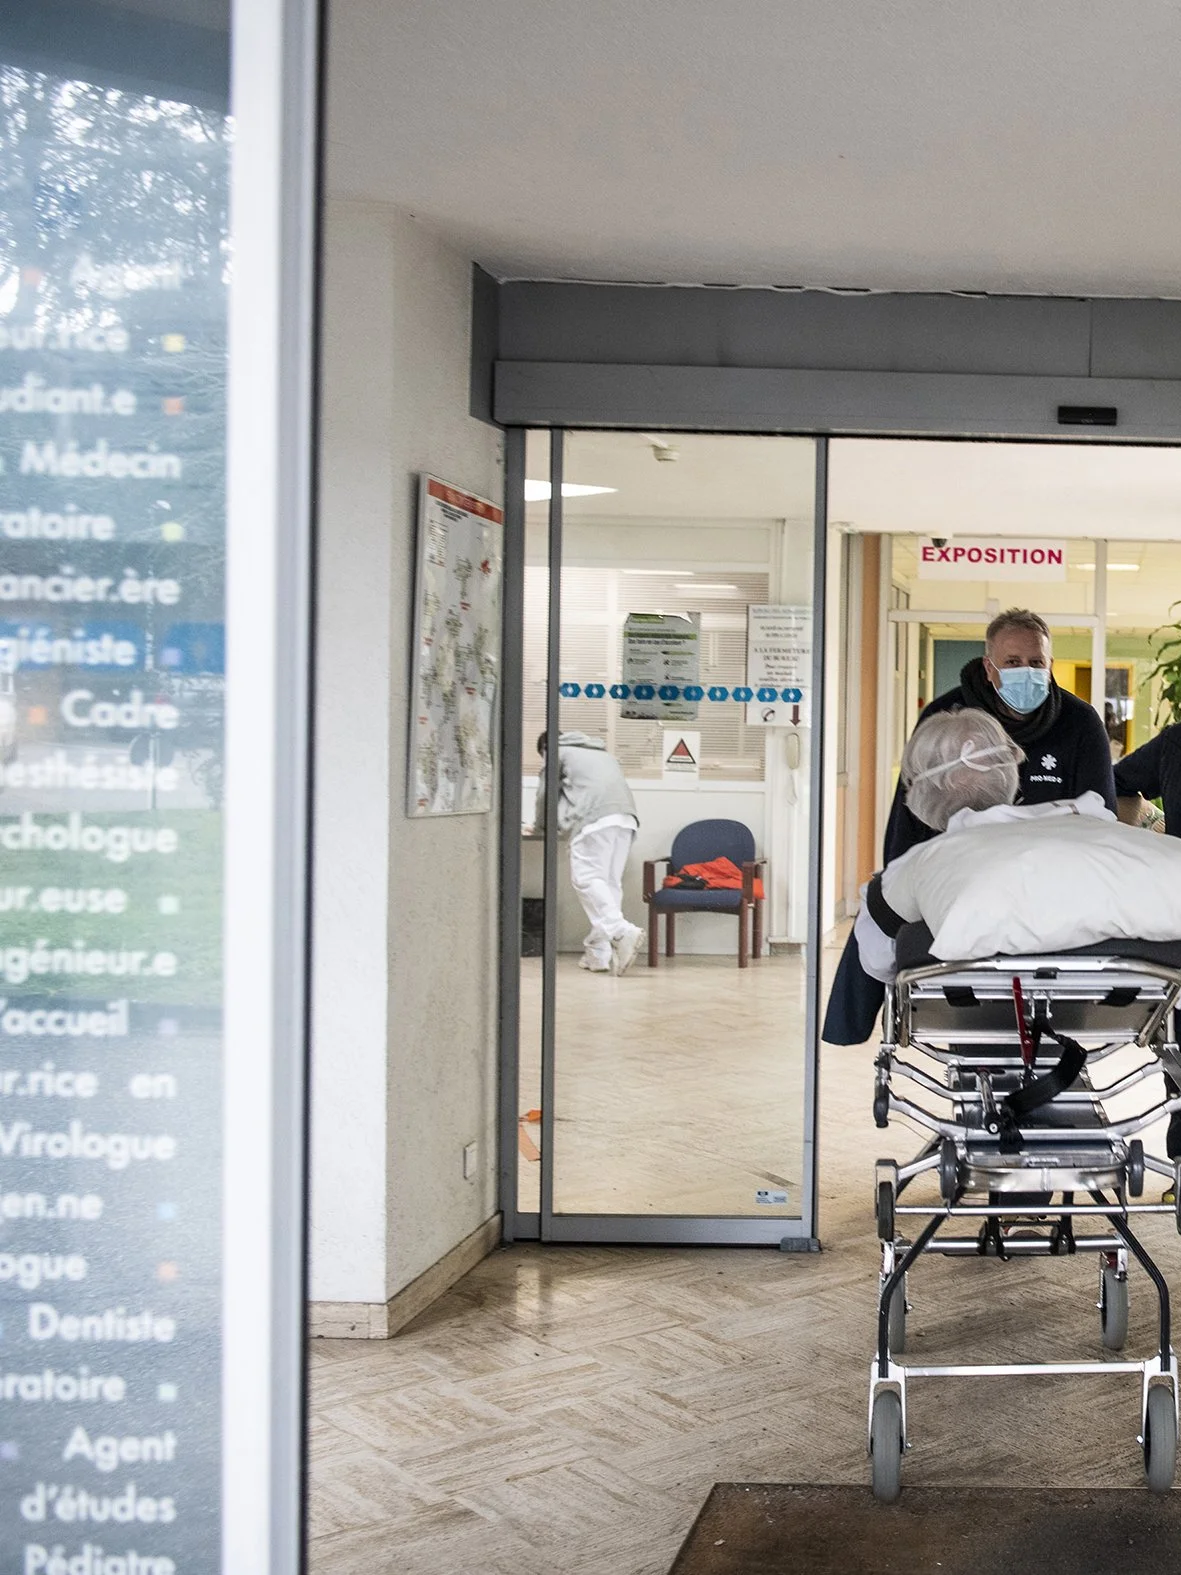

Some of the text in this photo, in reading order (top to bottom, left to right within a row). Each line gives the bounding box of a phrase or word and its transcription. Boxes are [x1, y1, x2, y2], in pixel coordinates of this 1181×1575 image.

[20, 438, 182, 479] Médecin
[0, 502, 115, 541] atoire
[922, 546, 1063, 565] EXPOSITION
[61, 685, 181, 730] Cadre
[0, 751, 181, 791] esthésiste
[0, 938, 178, 984] génieur.e
[129, 1073, 178, 1099] en
[0, 1119, 176, 1170] Virologue
[0, 1191, 103, 1224] en.ne
[28, 1302, 177, 1343] Dentiste
[0, 1365, 127, 1402] ratoire
[62, 1425, 178, 1473] Agent
[20, 1481, 178, 1523] d'études
[24, 1543, 177, 1575] Pédiatre
